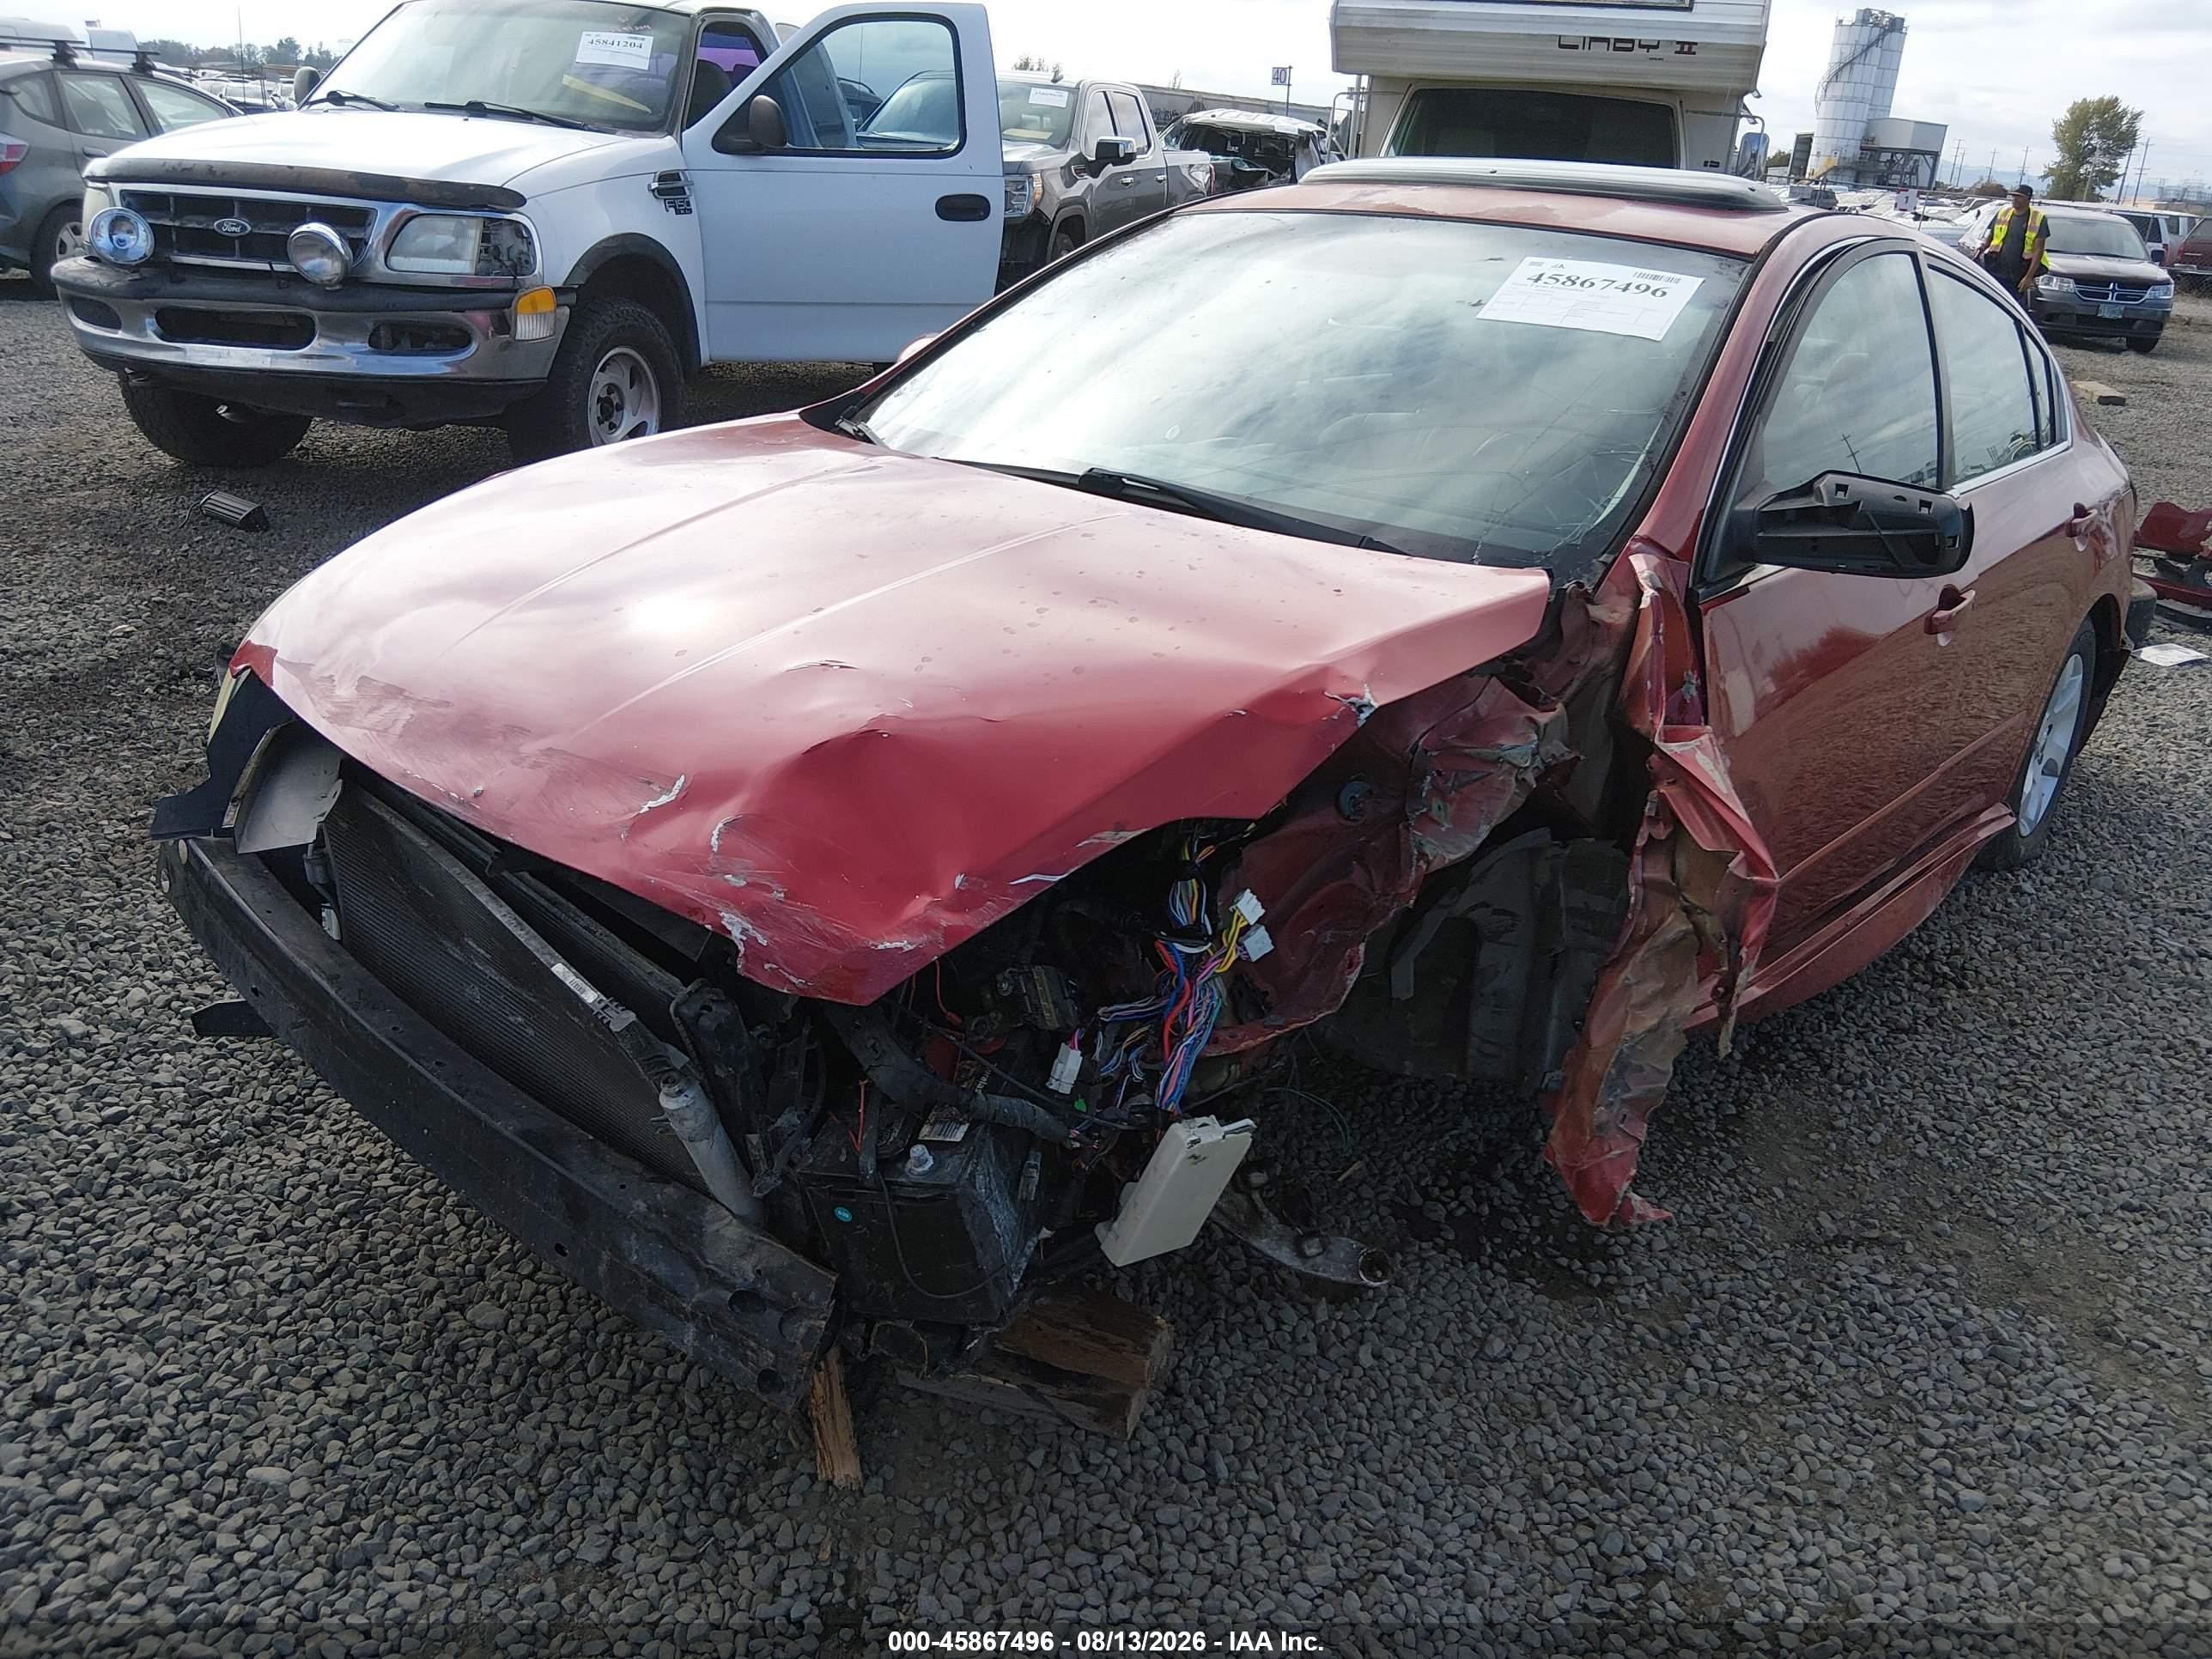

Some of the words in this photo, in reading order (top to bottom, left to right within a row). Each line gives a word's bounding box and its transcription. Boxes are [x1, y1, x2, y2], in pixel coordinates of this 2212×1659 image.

[587, 39, 643, 49] 45841204
[1273, 68, 1286, 83] 40
[222, 222, 241, 233] Ford
[1526, 271, 1671, 298] 45867496
